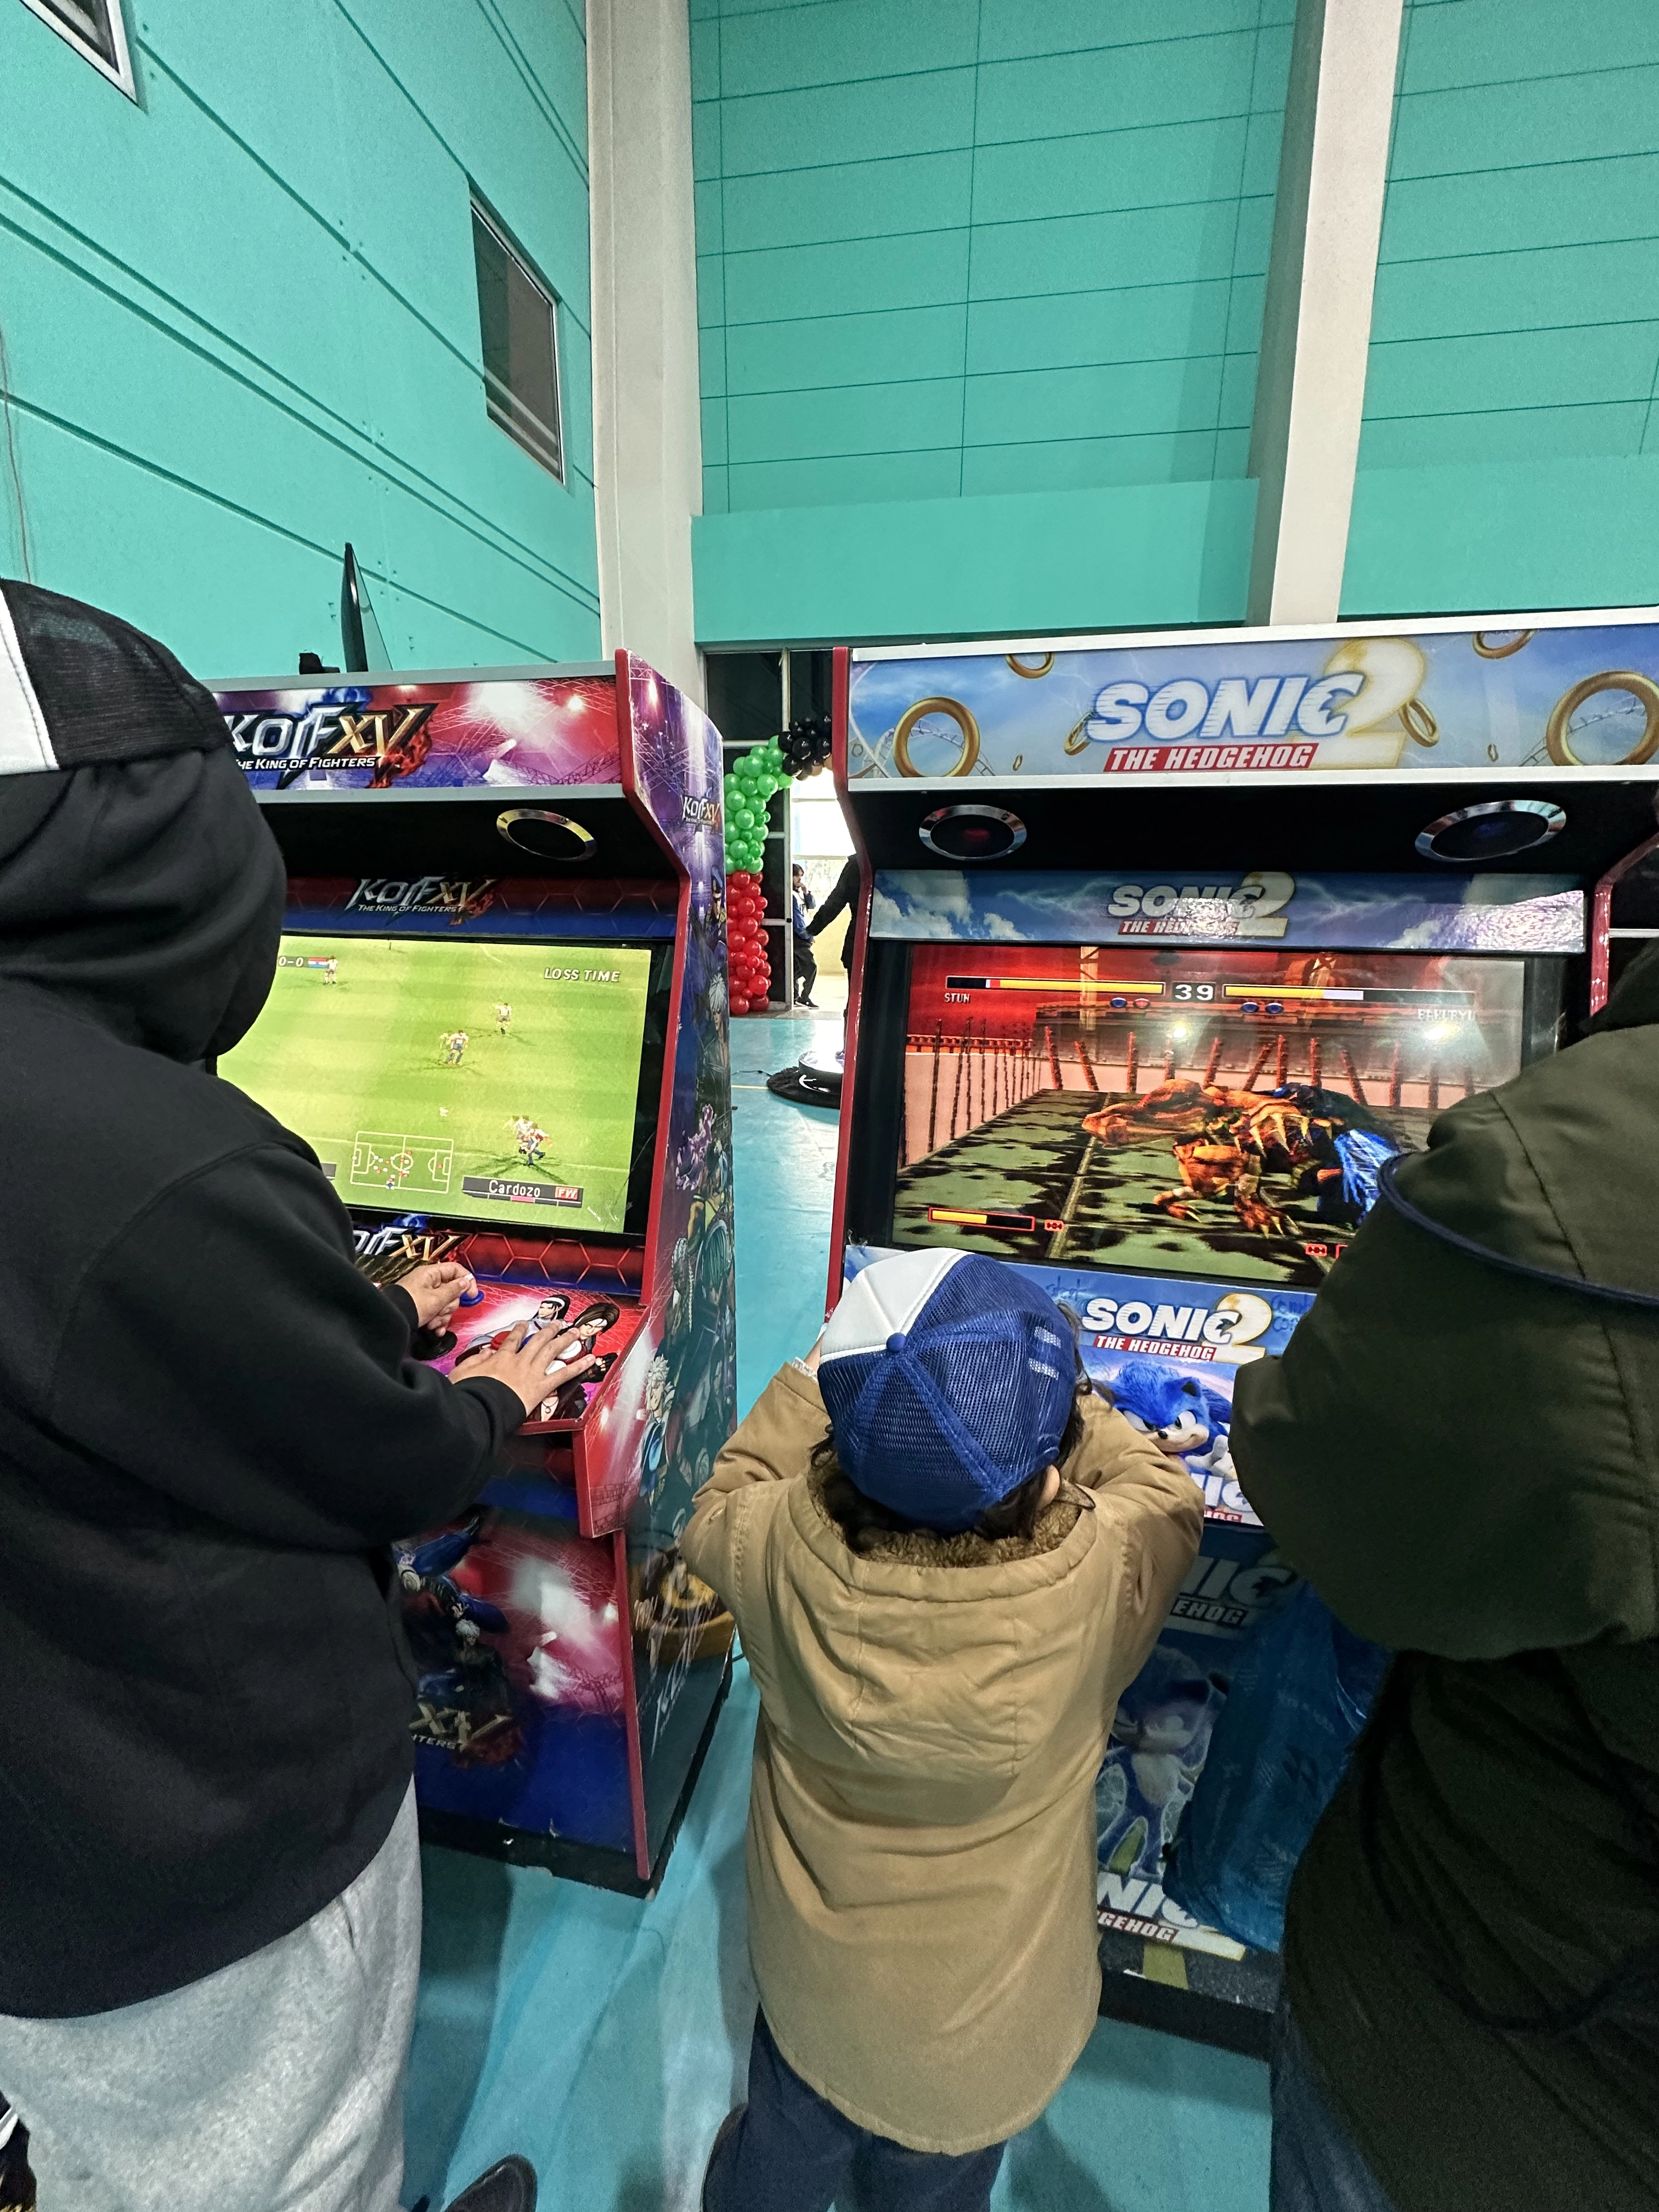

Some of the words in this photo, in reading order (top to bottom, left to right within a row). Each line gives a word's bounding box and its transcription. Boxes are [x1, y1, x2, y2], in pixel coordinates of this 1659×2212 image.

[1087, 672, 1365, 741] SONIC
[1294, 637, 1424, 768] 2
[236, 759, 253, 770] HE
[308, 757, 376, 768] FIGHTERS
[1111, 748, 1158, 771] THE
[1167, 745, 1314, 769] HEDGEHOG
[1122, 921, 1149, 933] THE
[544, 968, 580, 980] LOSS
[584, 969, 620, 983] TIME
[944, 992, 970, 1003] STUN
[1175, 984, 1214, 1001] 39
[489, 1180, 541, 1198] Cardozo
[557, 1188, 577, 1200] FW
[1081, 1298, 1240, 1344] SONIC
[1202, 1293, 1272, 1364] 2
[1097, 1335, 1126, 1350] THE
[1127, 1339, 1216, 1360] HEDGEHOG
[1172, 1599, 1244, 1625] EHOG
